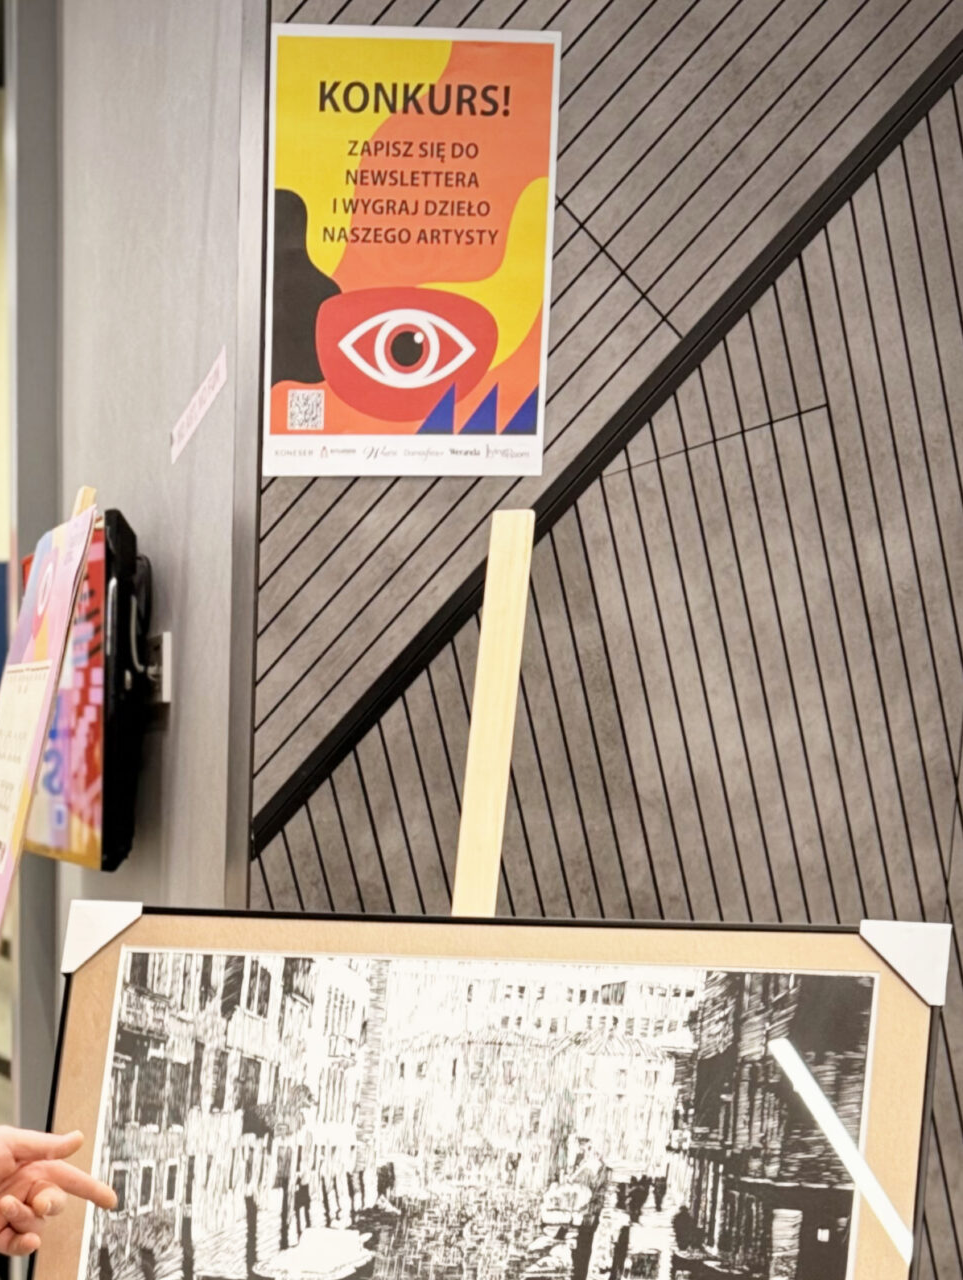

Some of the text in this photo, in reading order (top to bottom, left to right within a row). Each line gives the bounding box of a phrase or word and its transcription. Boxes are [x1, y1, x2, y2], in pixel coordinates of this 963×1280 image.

[319, 80, 511, 117] KONKURS!
[347, 139, 479, 164] ZAPISZ SIĘ DO
[345, 169, 480, 188] NEWSLETTERA
[332, 197, 491, 217] I WYGRAJ DZIEŁO
[322, 226, 499, 246] NASZEGO ARTYSTY
